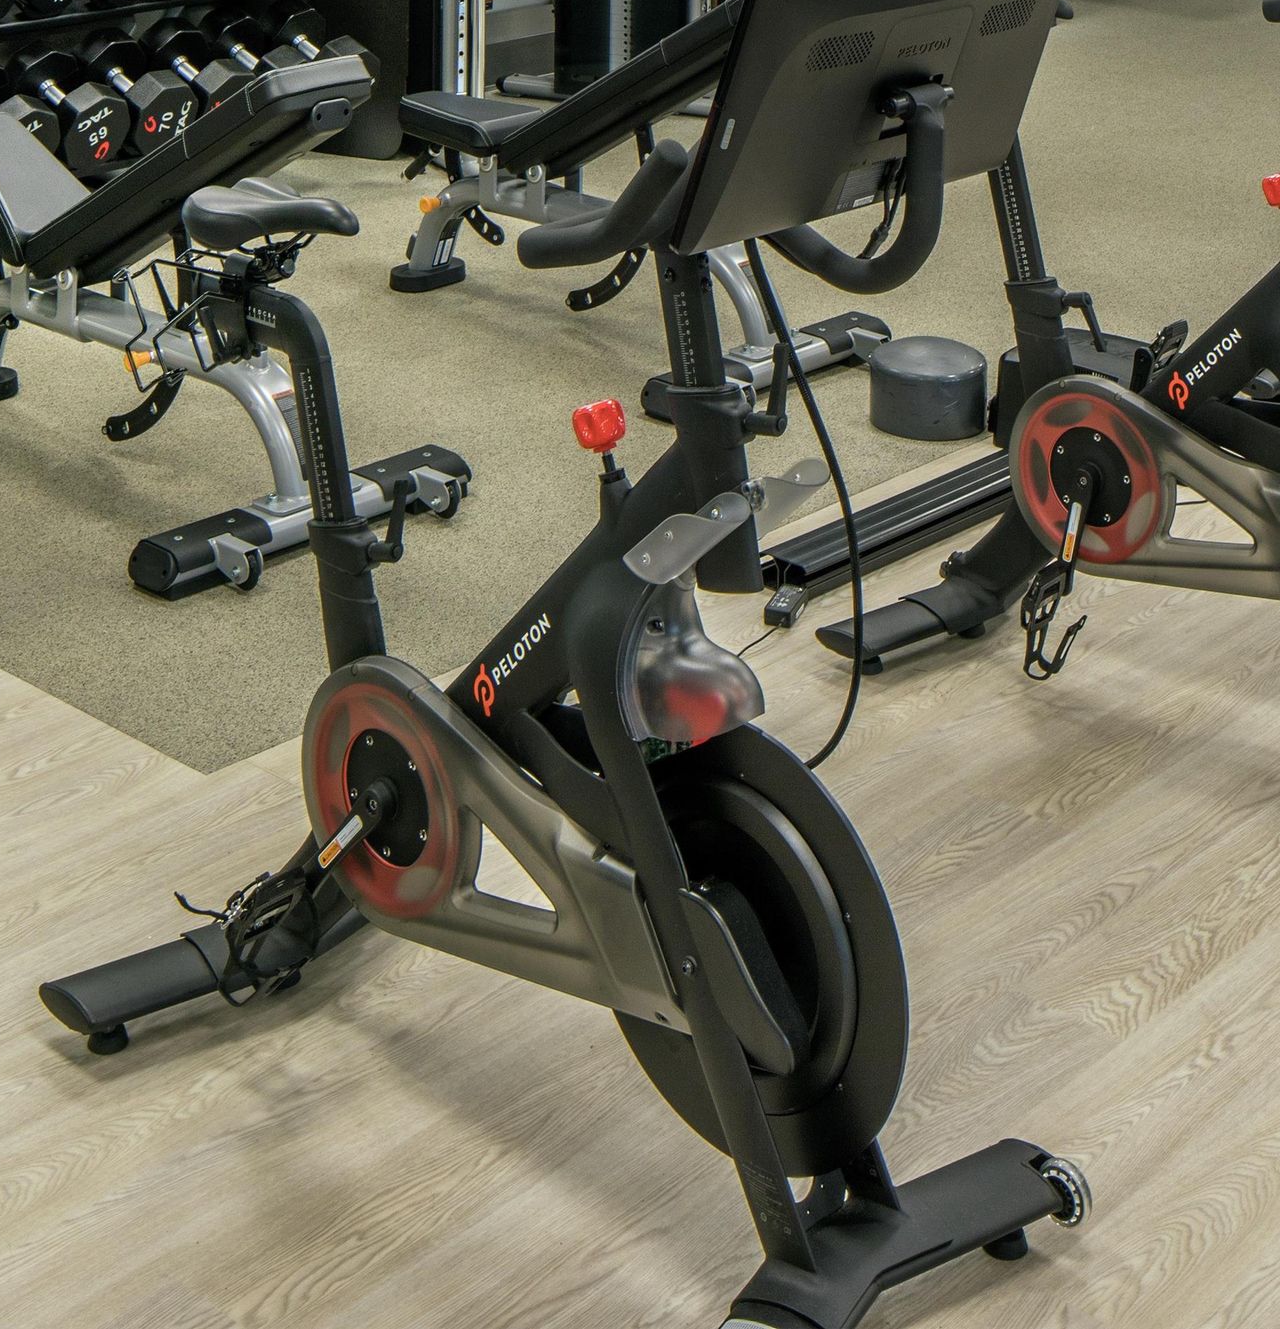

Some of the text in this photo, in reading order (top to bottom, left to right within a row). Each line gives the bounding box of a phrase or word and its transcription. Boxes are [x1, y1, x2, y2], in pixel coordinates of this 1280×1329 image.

[897, 37, 951, 59] PELOTON
[77, 106, 113, 133] TAG
[158, 111, 173, 133] 70
[175, 100, 193, 136] TAG
[89, 126, 108, 146] 65
[1185, 328, 1242, 386] PELOTON
[491, 612, 551, 686] PELOTON
